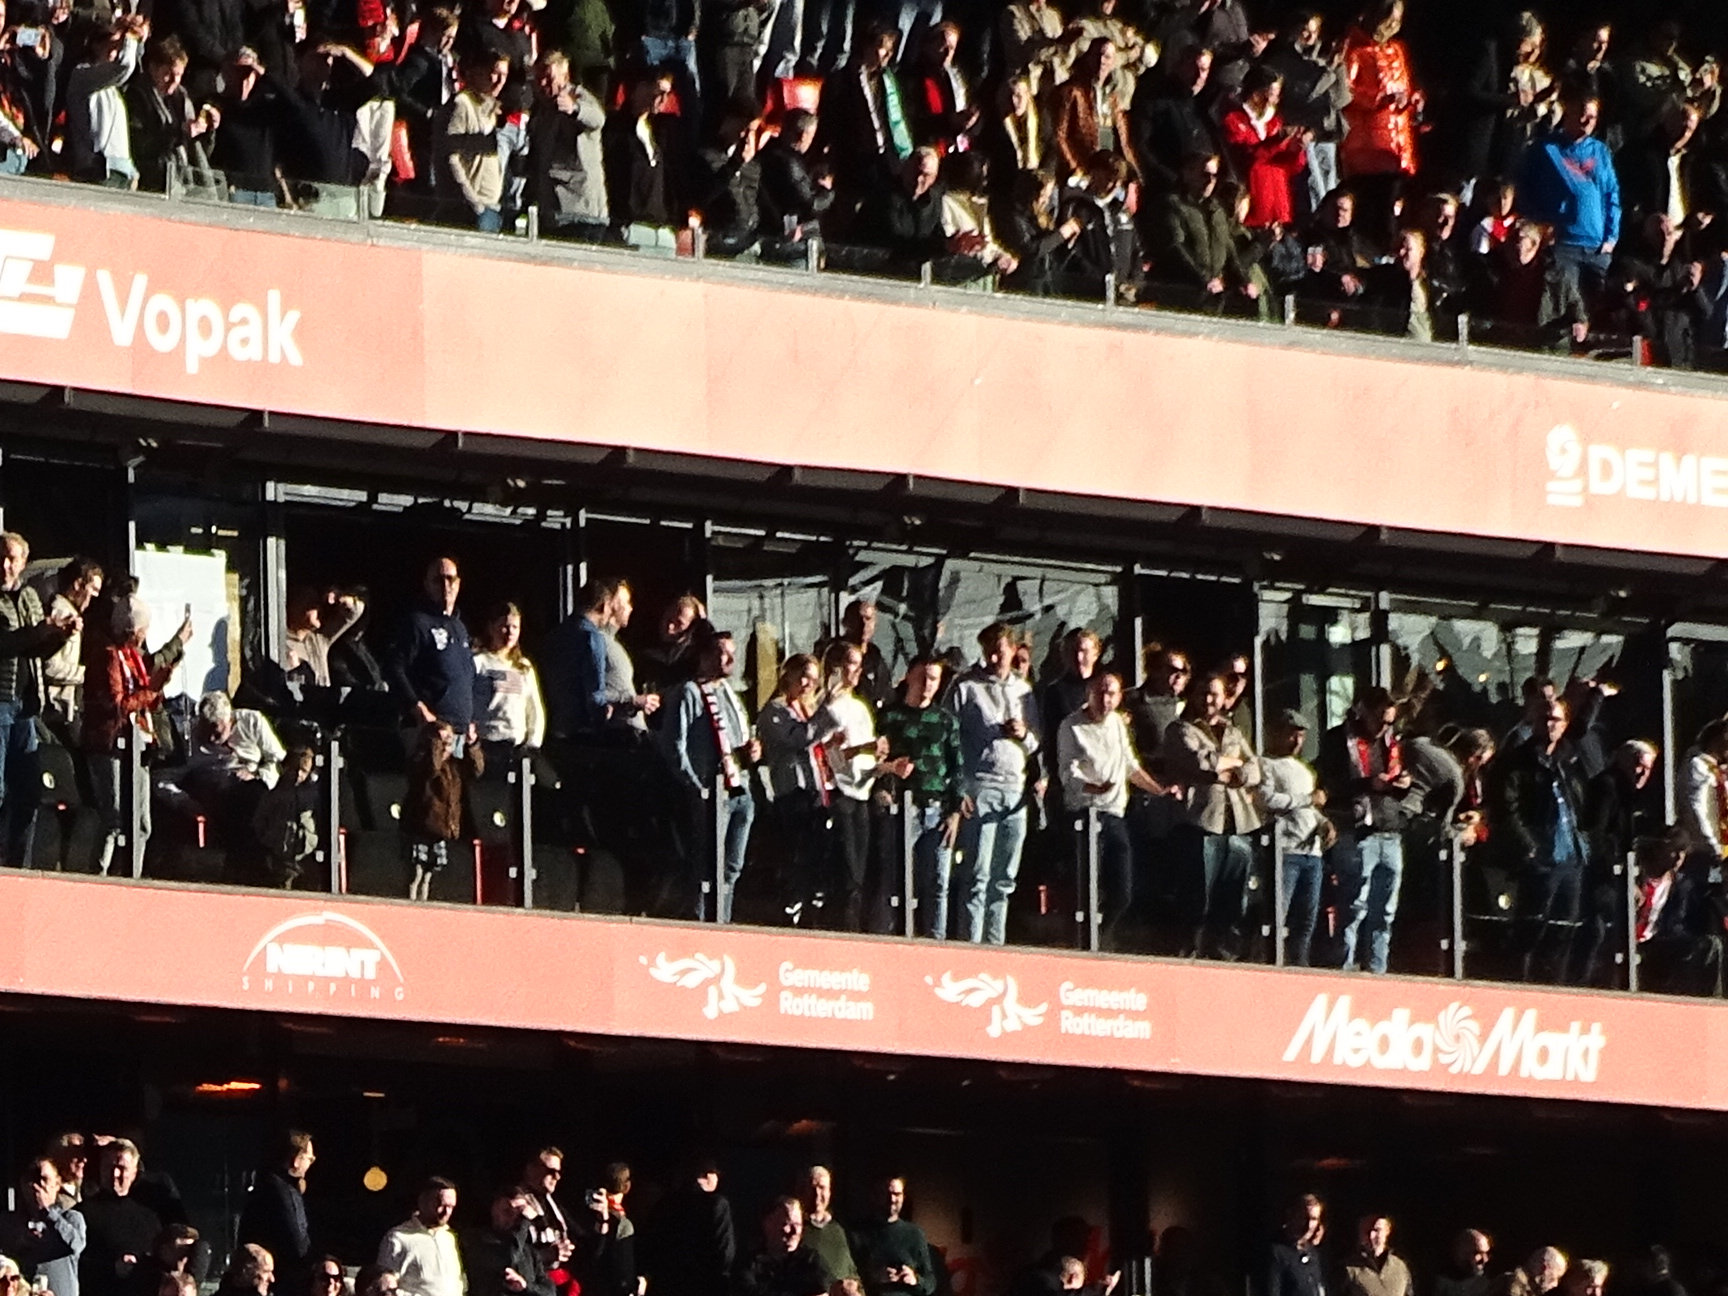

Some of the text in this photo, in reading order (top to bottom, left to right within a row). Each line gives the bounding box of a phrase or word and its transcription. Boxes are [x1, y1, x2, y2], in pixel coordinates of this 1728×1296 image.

[95, 269, 304, 375] Vopak
[1587, 444, 1728, 508] DEME
[242, 976, 404, 1001] SHIPPING
[778, 961, 871, 992] Gemeente
[779, 991, 874, 1021] Rotterdam
[1059, 981, 1148, 1012] Gemeente
[1060, 1010, 1152, 1040] Rotterdam
